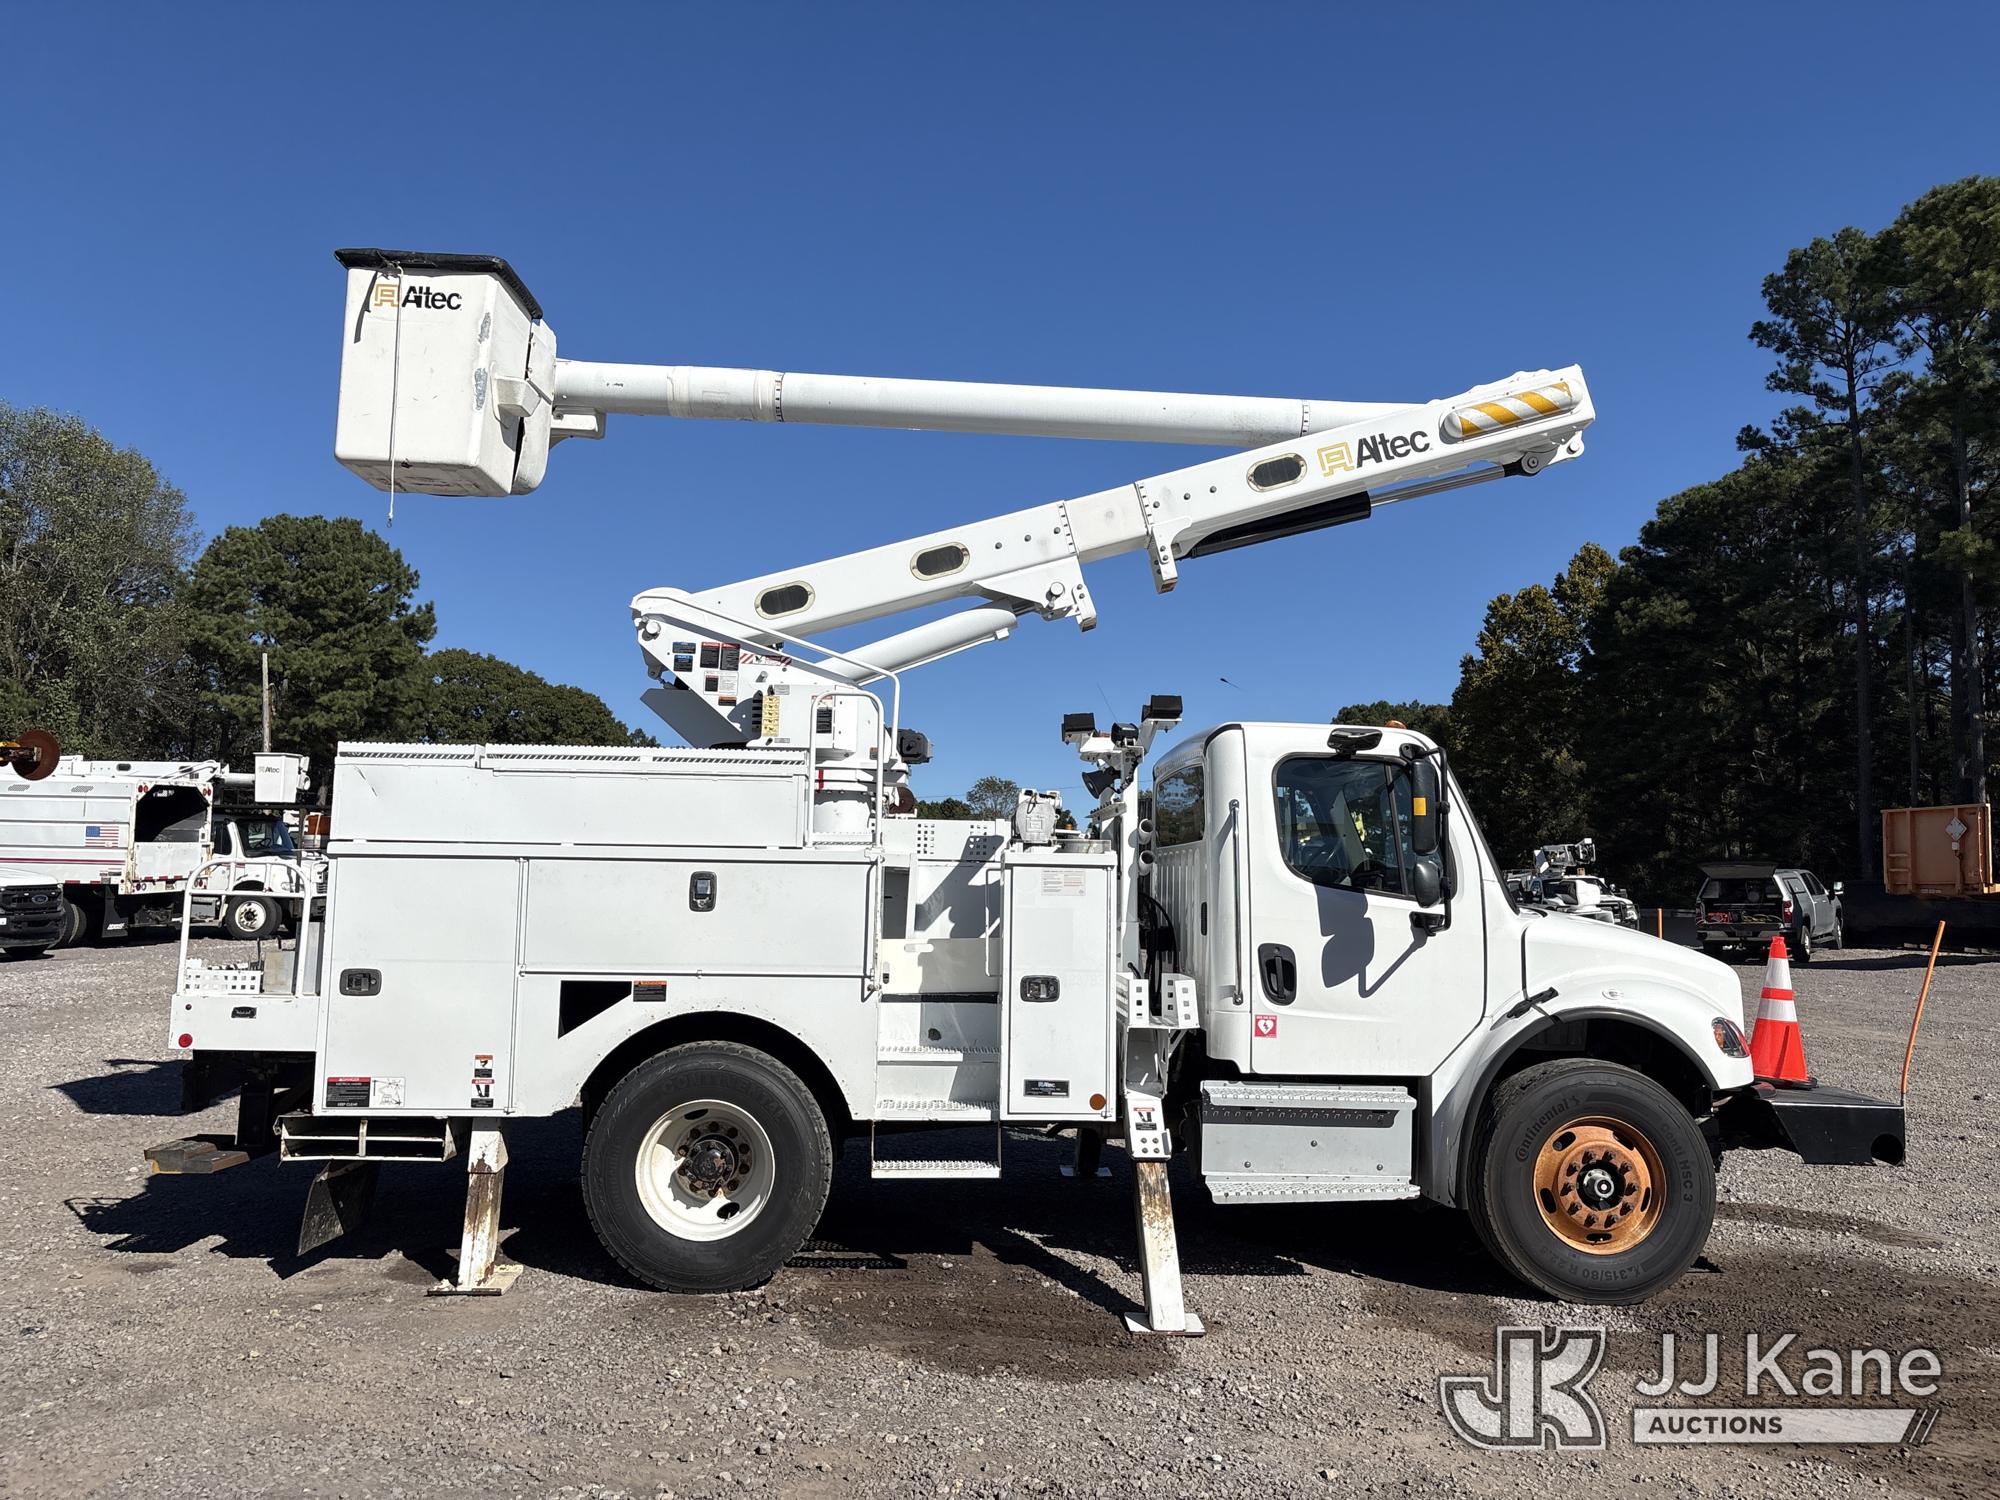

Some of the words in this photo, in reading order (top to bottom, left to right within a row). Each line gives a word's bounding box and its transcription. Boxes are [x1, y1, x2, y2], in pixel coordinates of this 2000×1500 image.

[402, 285, 462, 310] Altec
[1356, 430, 1430, 468] Altec
[1680, 1160, 1693, 1189] HSC
[1683, 1193, 1693, 1202] 3
[1582, 1268, 1628, 1281] 315/80
